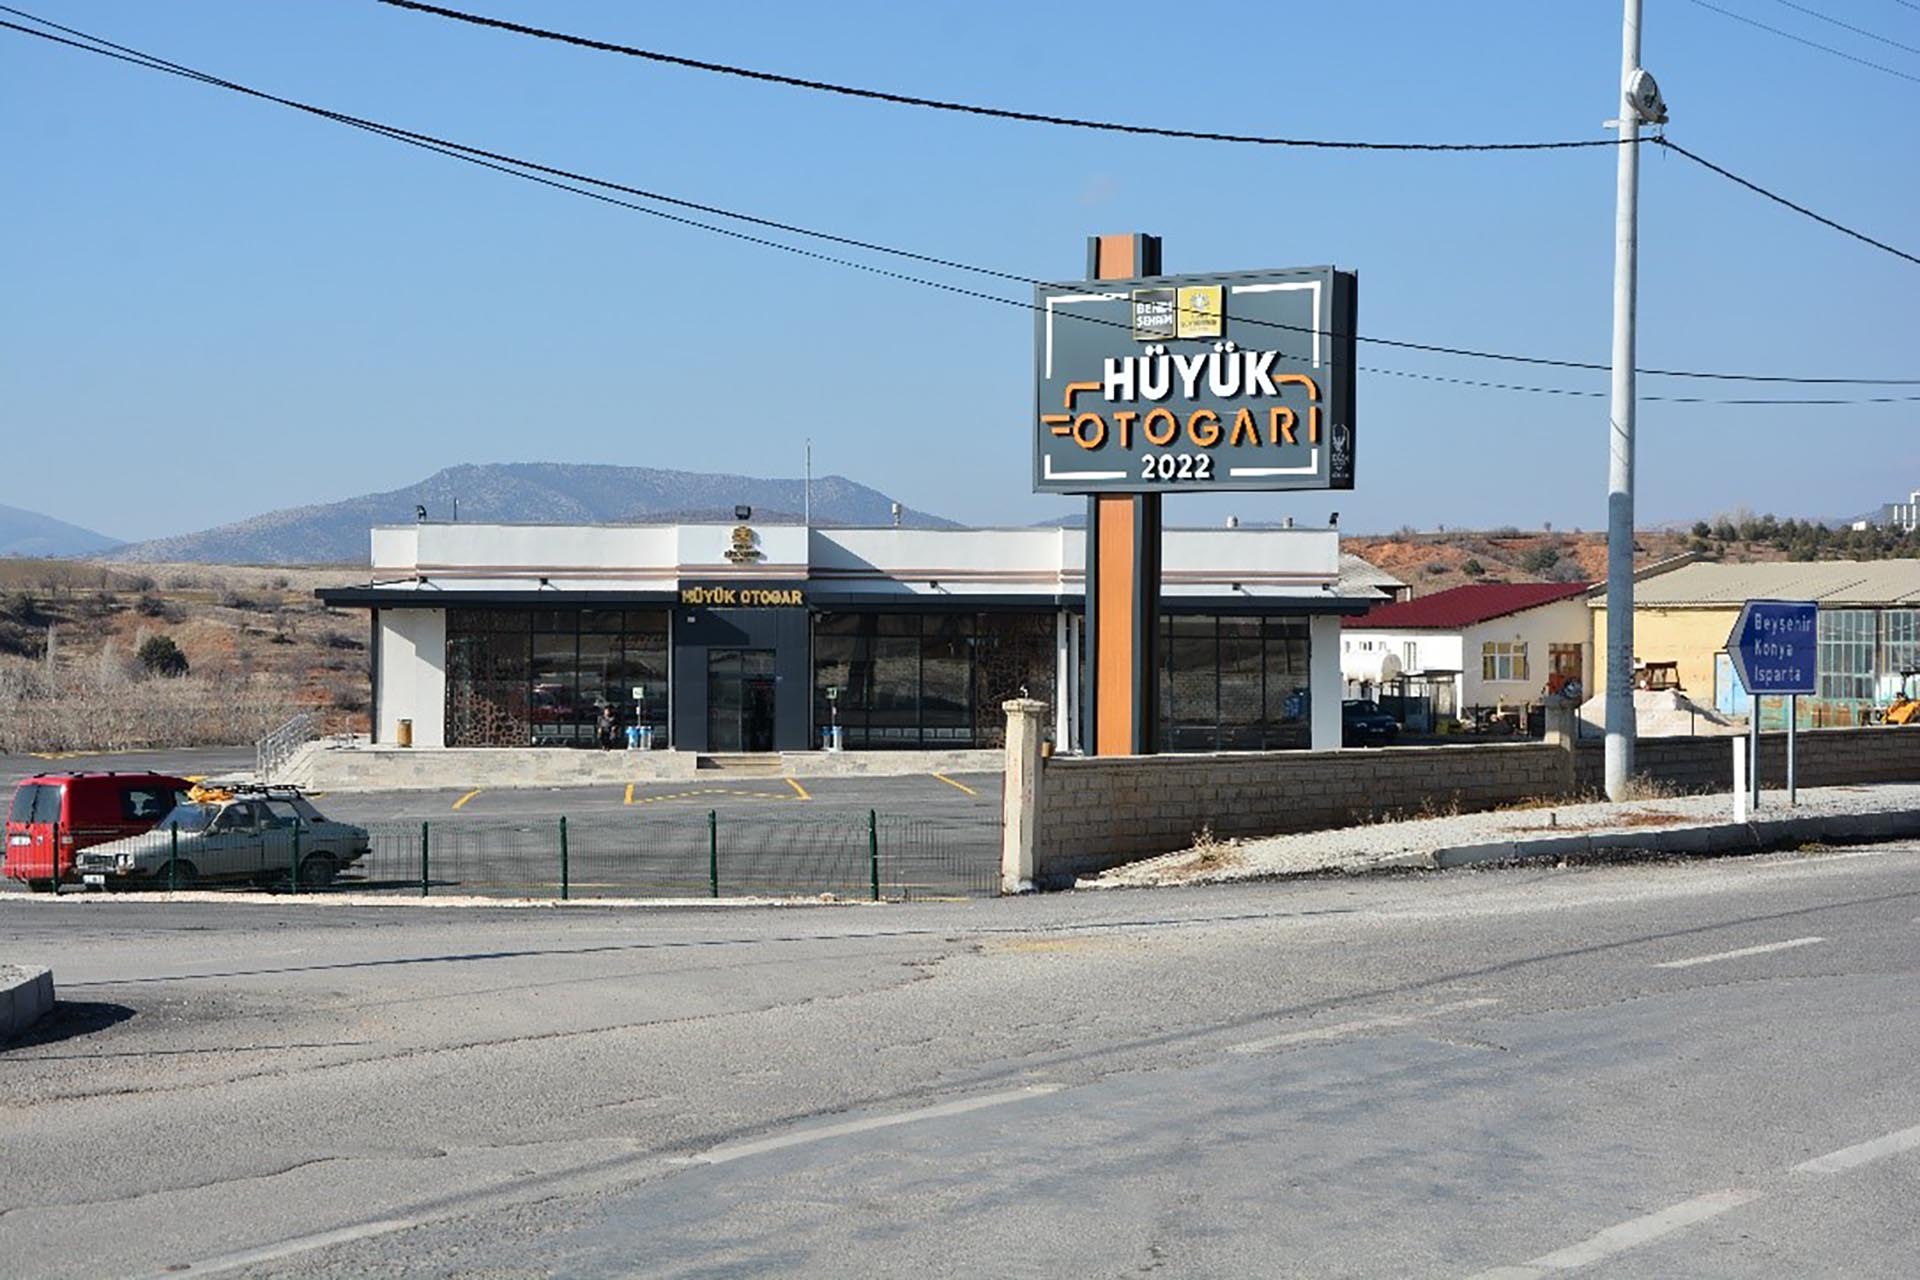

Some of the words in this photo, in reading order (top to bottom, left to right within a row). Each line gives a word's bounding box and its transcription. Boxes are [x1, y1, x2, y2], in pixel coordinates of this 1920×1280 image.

[1104, 341, 1277, 400] HÜYÜK
[1141, 454, 1210, 479] 2022
[682, 586, 736, 603] HÜYÜK
[741, 590, 802, 604] OTOGAR
[1755, 639, 1793, 659] Konya
[1755, 666, 1801, 686] Isparta
